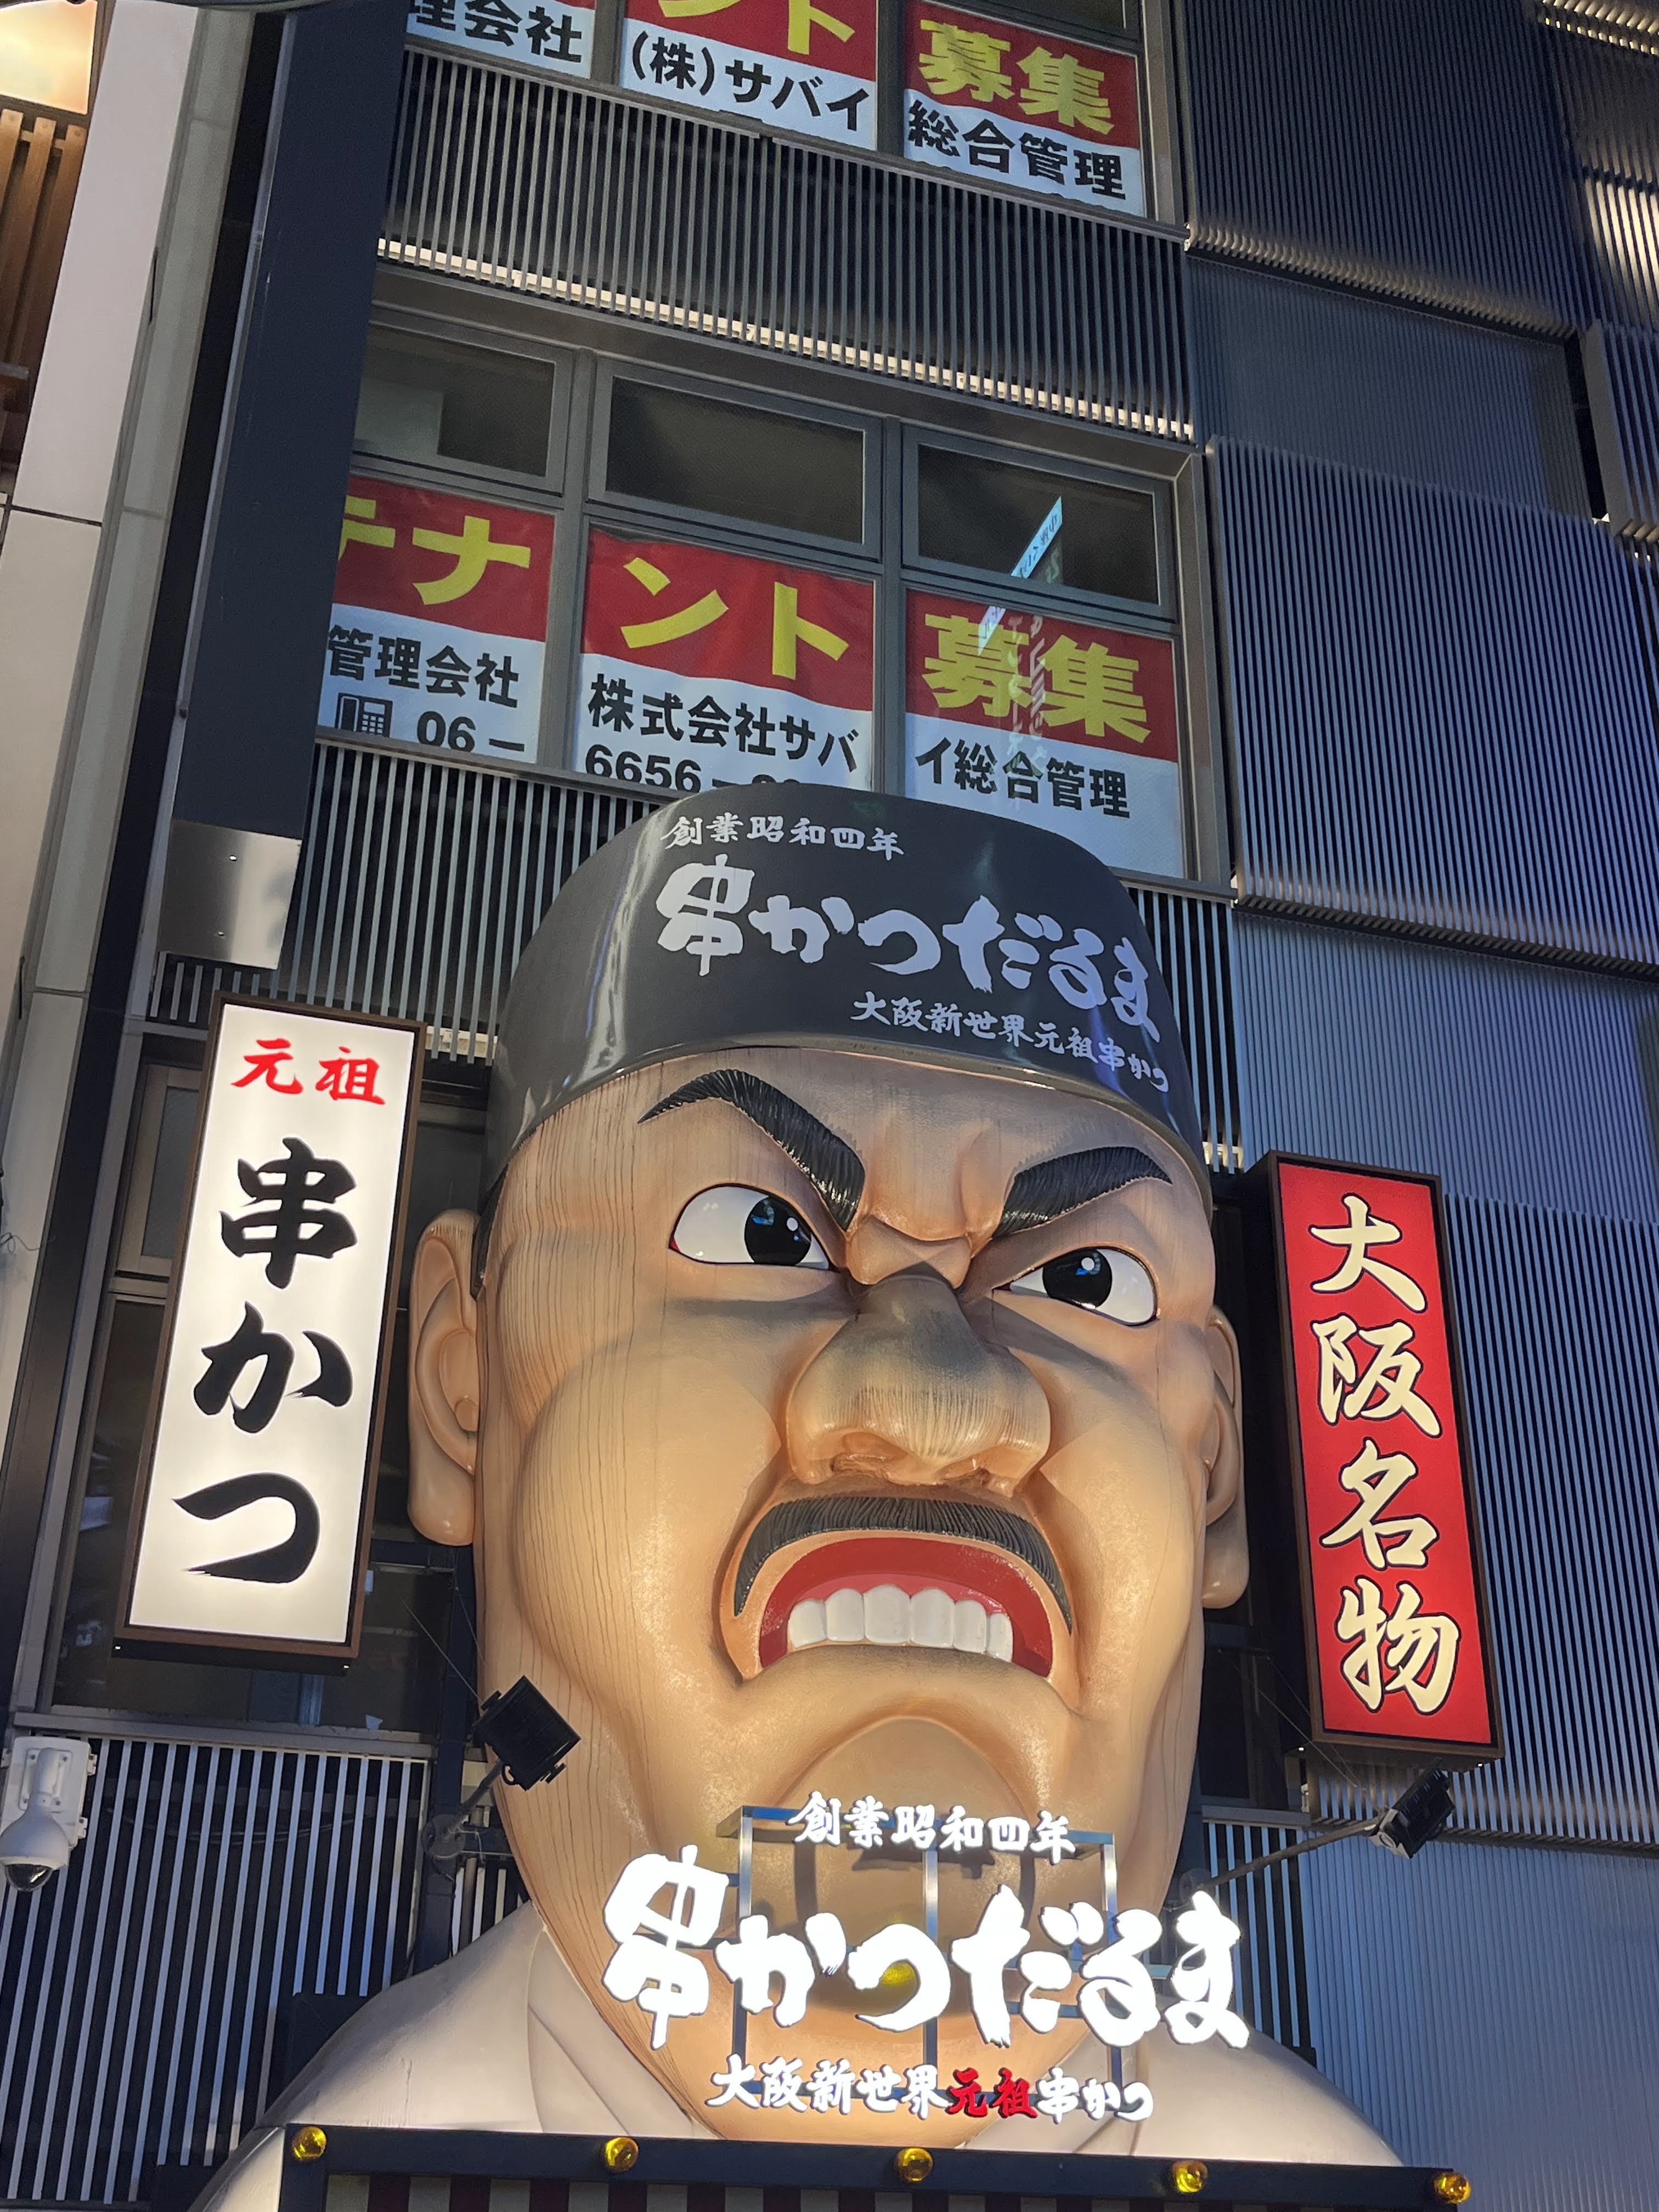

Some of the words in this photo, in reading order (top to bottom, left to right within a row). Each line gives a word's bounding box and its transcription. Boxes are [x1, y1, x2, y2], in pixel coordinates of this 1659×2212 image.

[659, 0, 855, 55] ト
[918, 19, 1114, 135] 募集
[632, 31, 870, 132] (株)サバイ
[909, 100, 1126, 200] 総合管理
[329, 624, 519, 708] 管理会社
[620, 557, 849, 680] ント
[588, 673, 859, 772] 株式会社サバ
[922, 613, 1152, 743] 募集
[916, 737, 1130, 819] イ総合管理
[660, 812, 904, 861] 創業昭和四年
[656, 854, 1160, 1042] 串かつだるま
[231, 1039, 385, 1105] 元祖
[850, 991, 1169, 1093] 大阪新世界元祖串かつ
[172, 1137, 358, 1584] 串かつ
[1310, 1193, 1460, 1713] 大阪名物
[787, 1790, 1076, 1864] 創業昭和四年
[602, 1844, 1250, 2049] 串かつだるま
[705, 2052, 1154, 2124] 大阪新世界元祖串かつ
